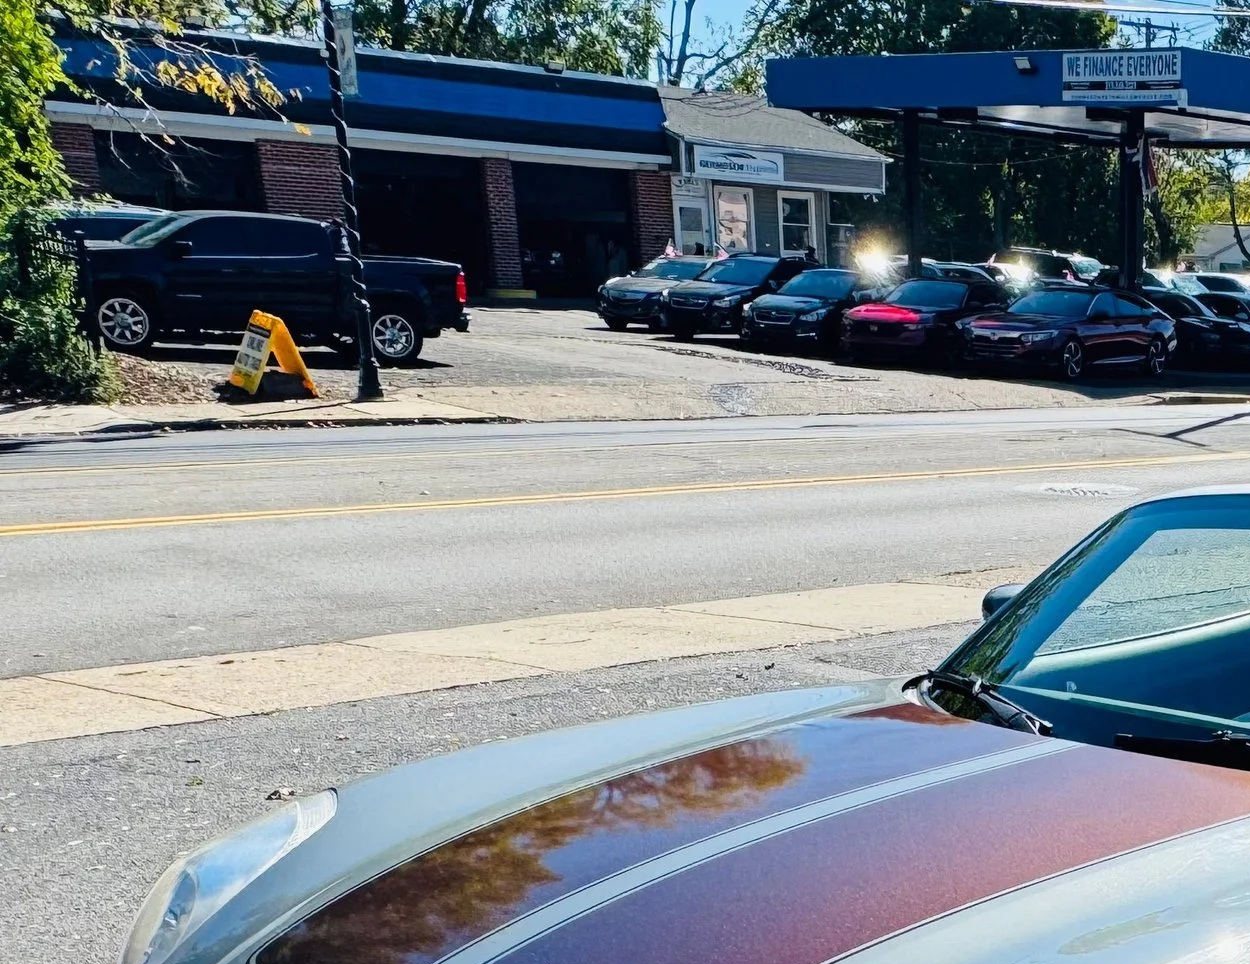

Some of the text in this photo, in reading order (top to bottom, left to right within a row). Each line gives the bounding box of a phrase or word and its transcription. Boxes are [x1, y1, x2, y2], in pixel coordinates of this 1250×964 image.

[1067, 53, 1178, 77] WE FINANCE EVERYONE
